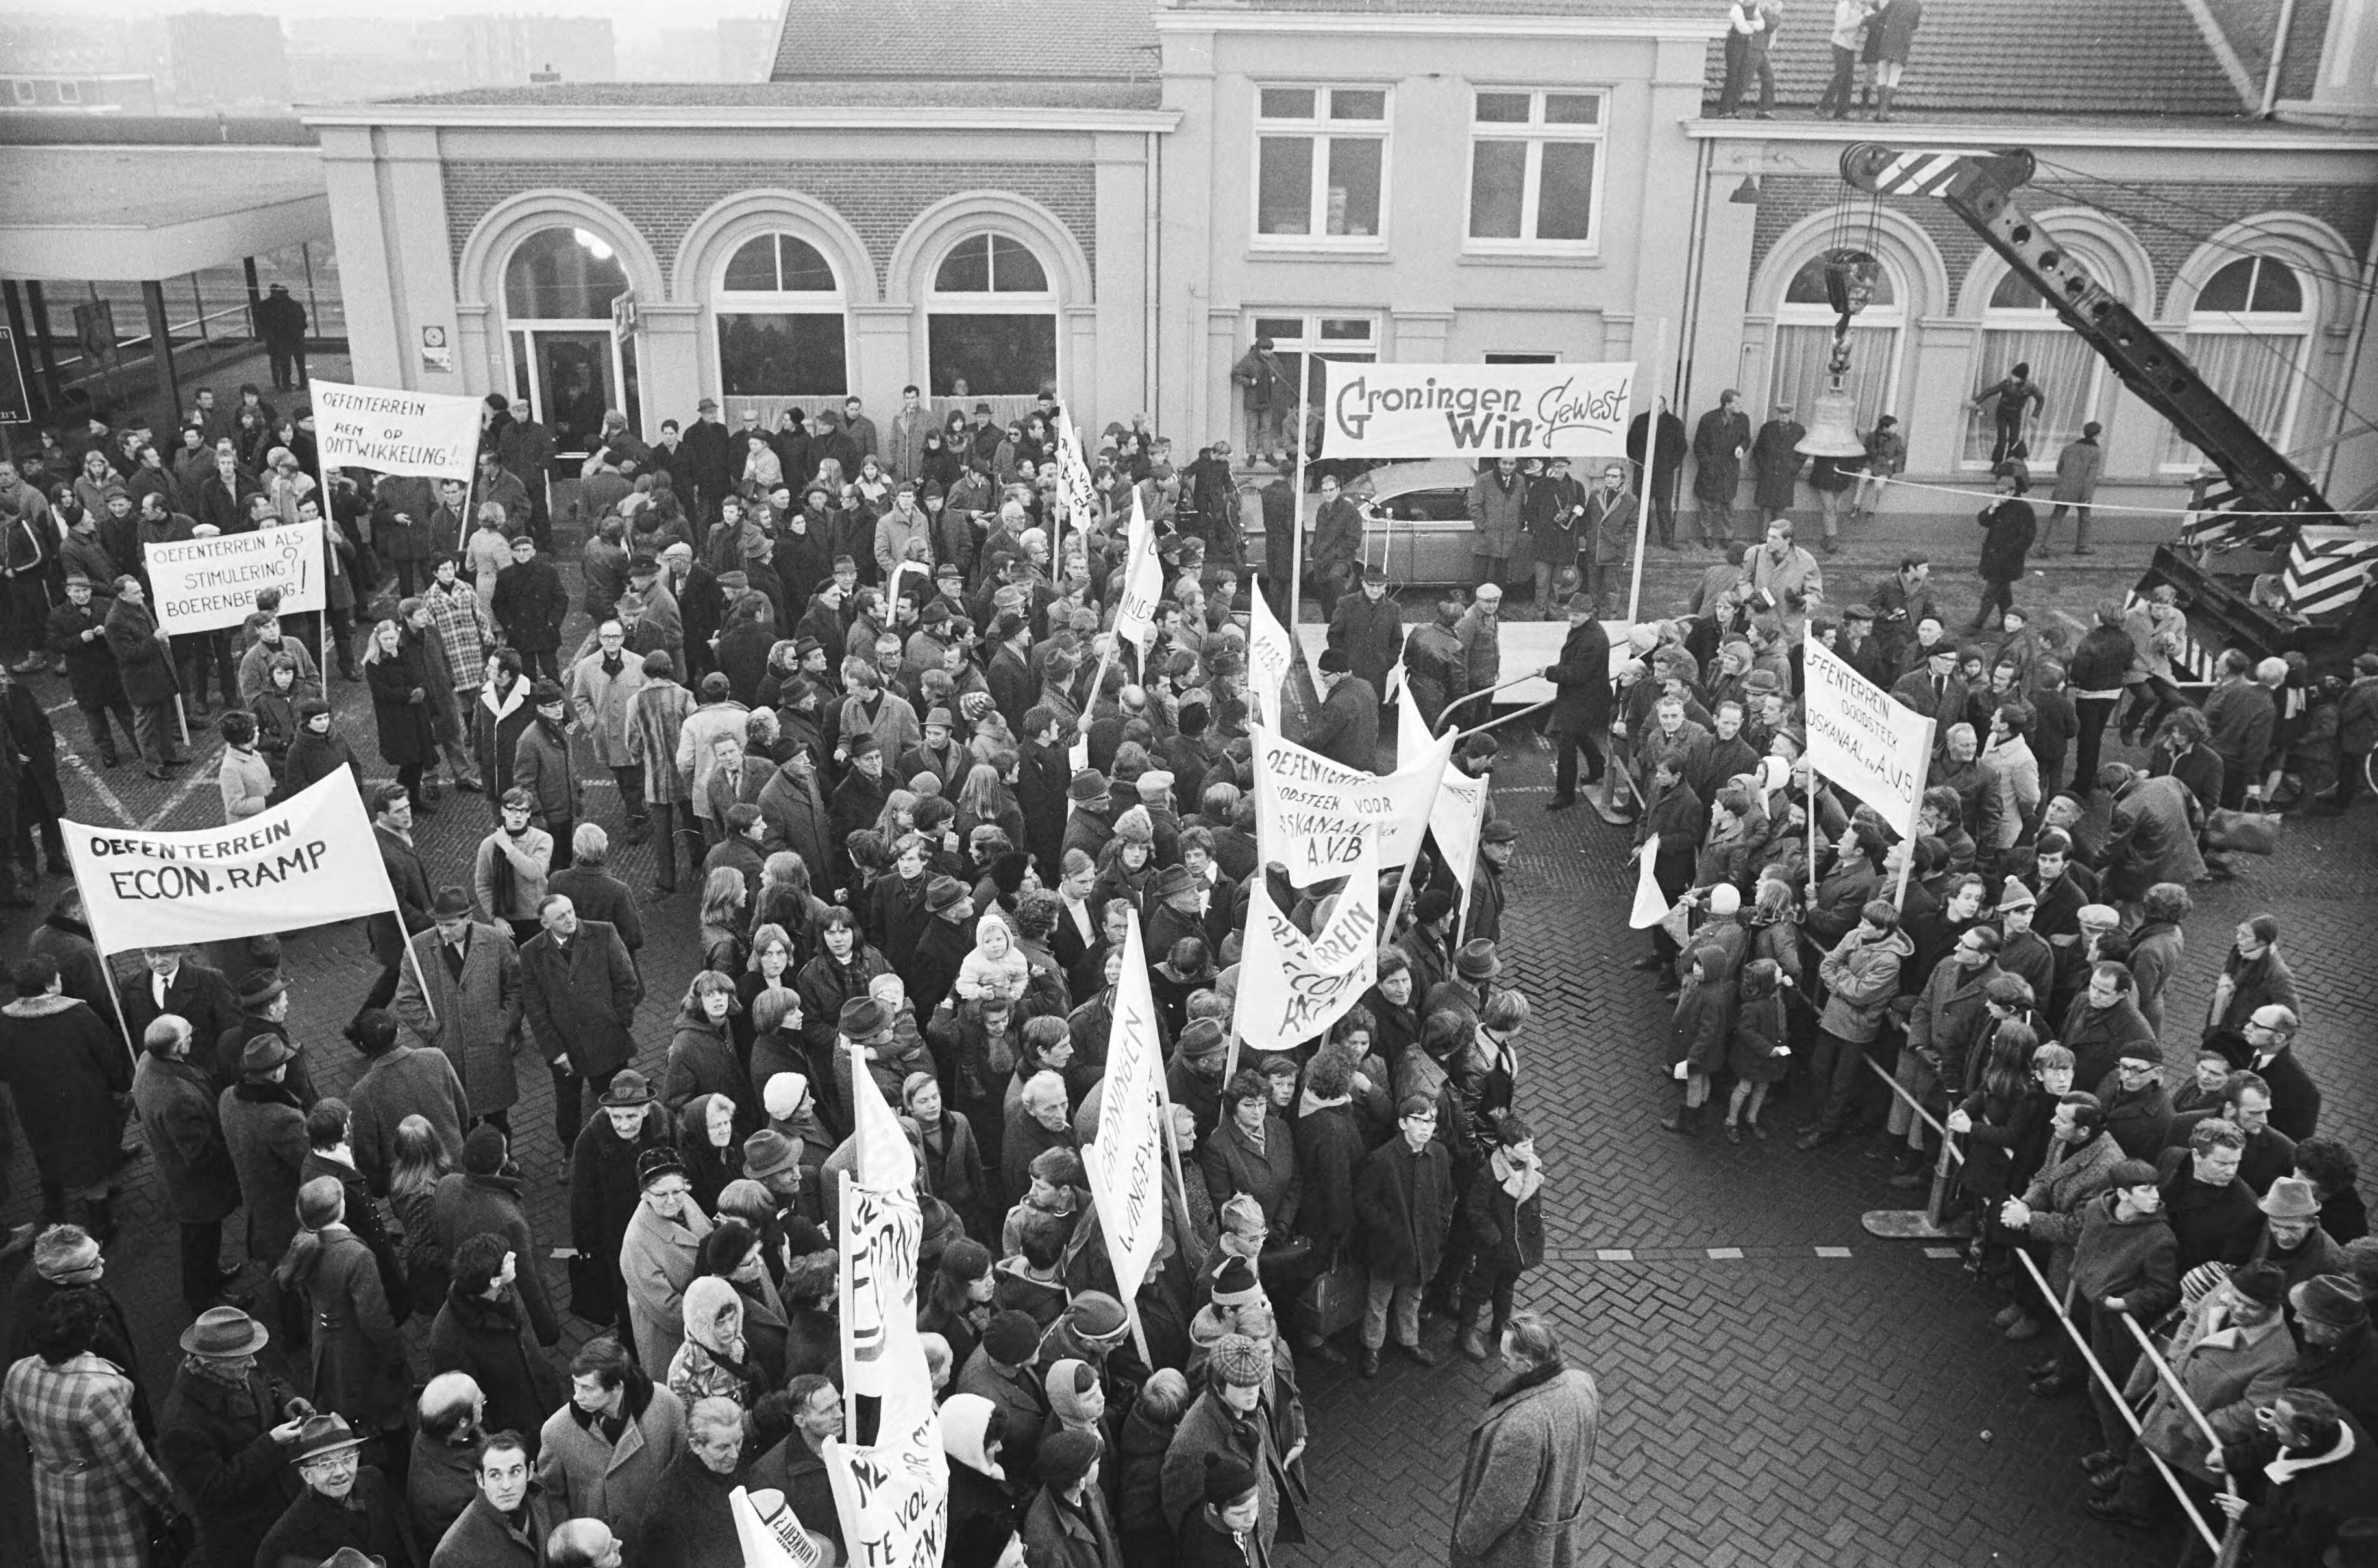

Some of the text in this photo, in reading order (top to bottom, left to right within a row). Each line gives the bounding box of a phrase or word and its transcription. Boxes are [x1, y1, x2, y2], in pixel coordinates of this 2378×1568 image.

[323, 391, 426, 417] OEFENTERREIN
[1336, 376, 1628, 448] Groningen Gewest
[334, 422, 403, 439] REM OP
[153, 530, 304, 564] OEFENTERREIN ALS
[1355, 796, 1393, 813] VOOR
[90, 819, 291, 861] OEFENTERREIN
[1102, 1005, 1143, 1193] GRONINGEN
